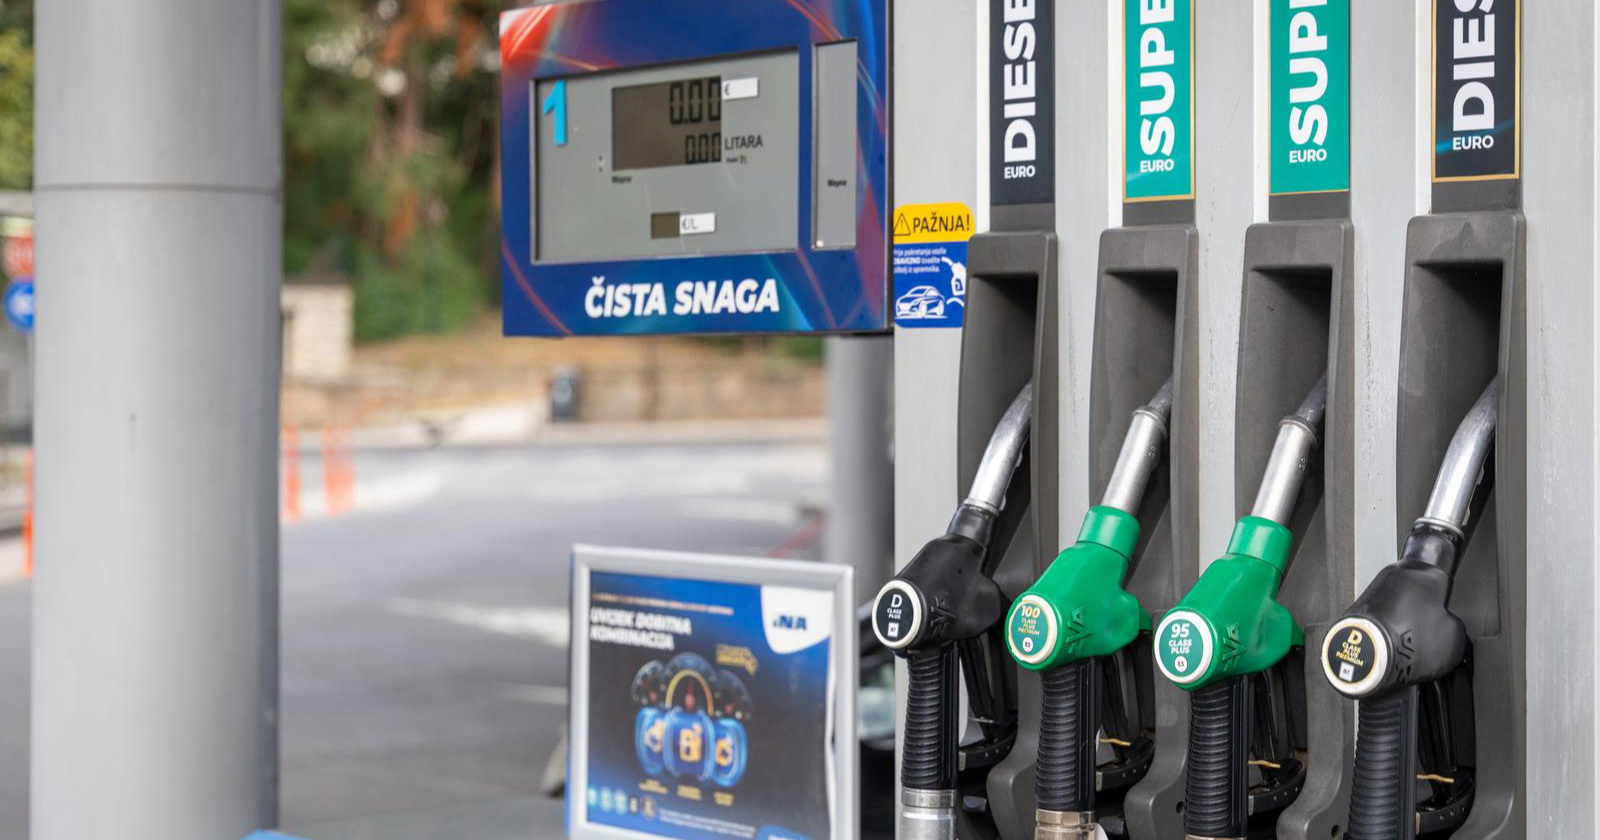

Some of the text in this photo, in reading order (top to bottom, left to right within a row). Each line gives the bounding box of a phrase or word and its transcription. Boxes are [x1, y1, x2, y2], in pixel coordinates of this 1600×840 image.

[1289, 0, 1328, 146] SUP
[724, 83, 732, 97] €
[669, 77, 721, 126] 0.00
[543, 79, 568, 147] 1
[724, 134, 764, 151] LITARA
[1453, 135, 1494, 150] EURO
[1289, 149, 1327, 163] EURO
[1004, 165, 1036, 179] EURO
[1139, 158, 1175, 173] EURO
[682, 217, 698, 231] €/L
[912, 211, 970, 234] PAŽNJA!
[585, 276, 780, 318] ČISTA SNAGA
[890, 594, 902, 608] D
[1021, 605, 1041, 619] 100
[1018, 627, 1040, 636] PREMIUM
[1170, 623, 1191, 639] 95
[1347, 629, 1362, 645] D
[1168, 639, 1192, 647] CLASS
[1171, 646, 1190, 654] PLUS
[1342, 642, 1361, 651] CLASS
[1336, 651, 1363, 667] PREMIUM
[1343, 648, 1360, 659] PLUS
